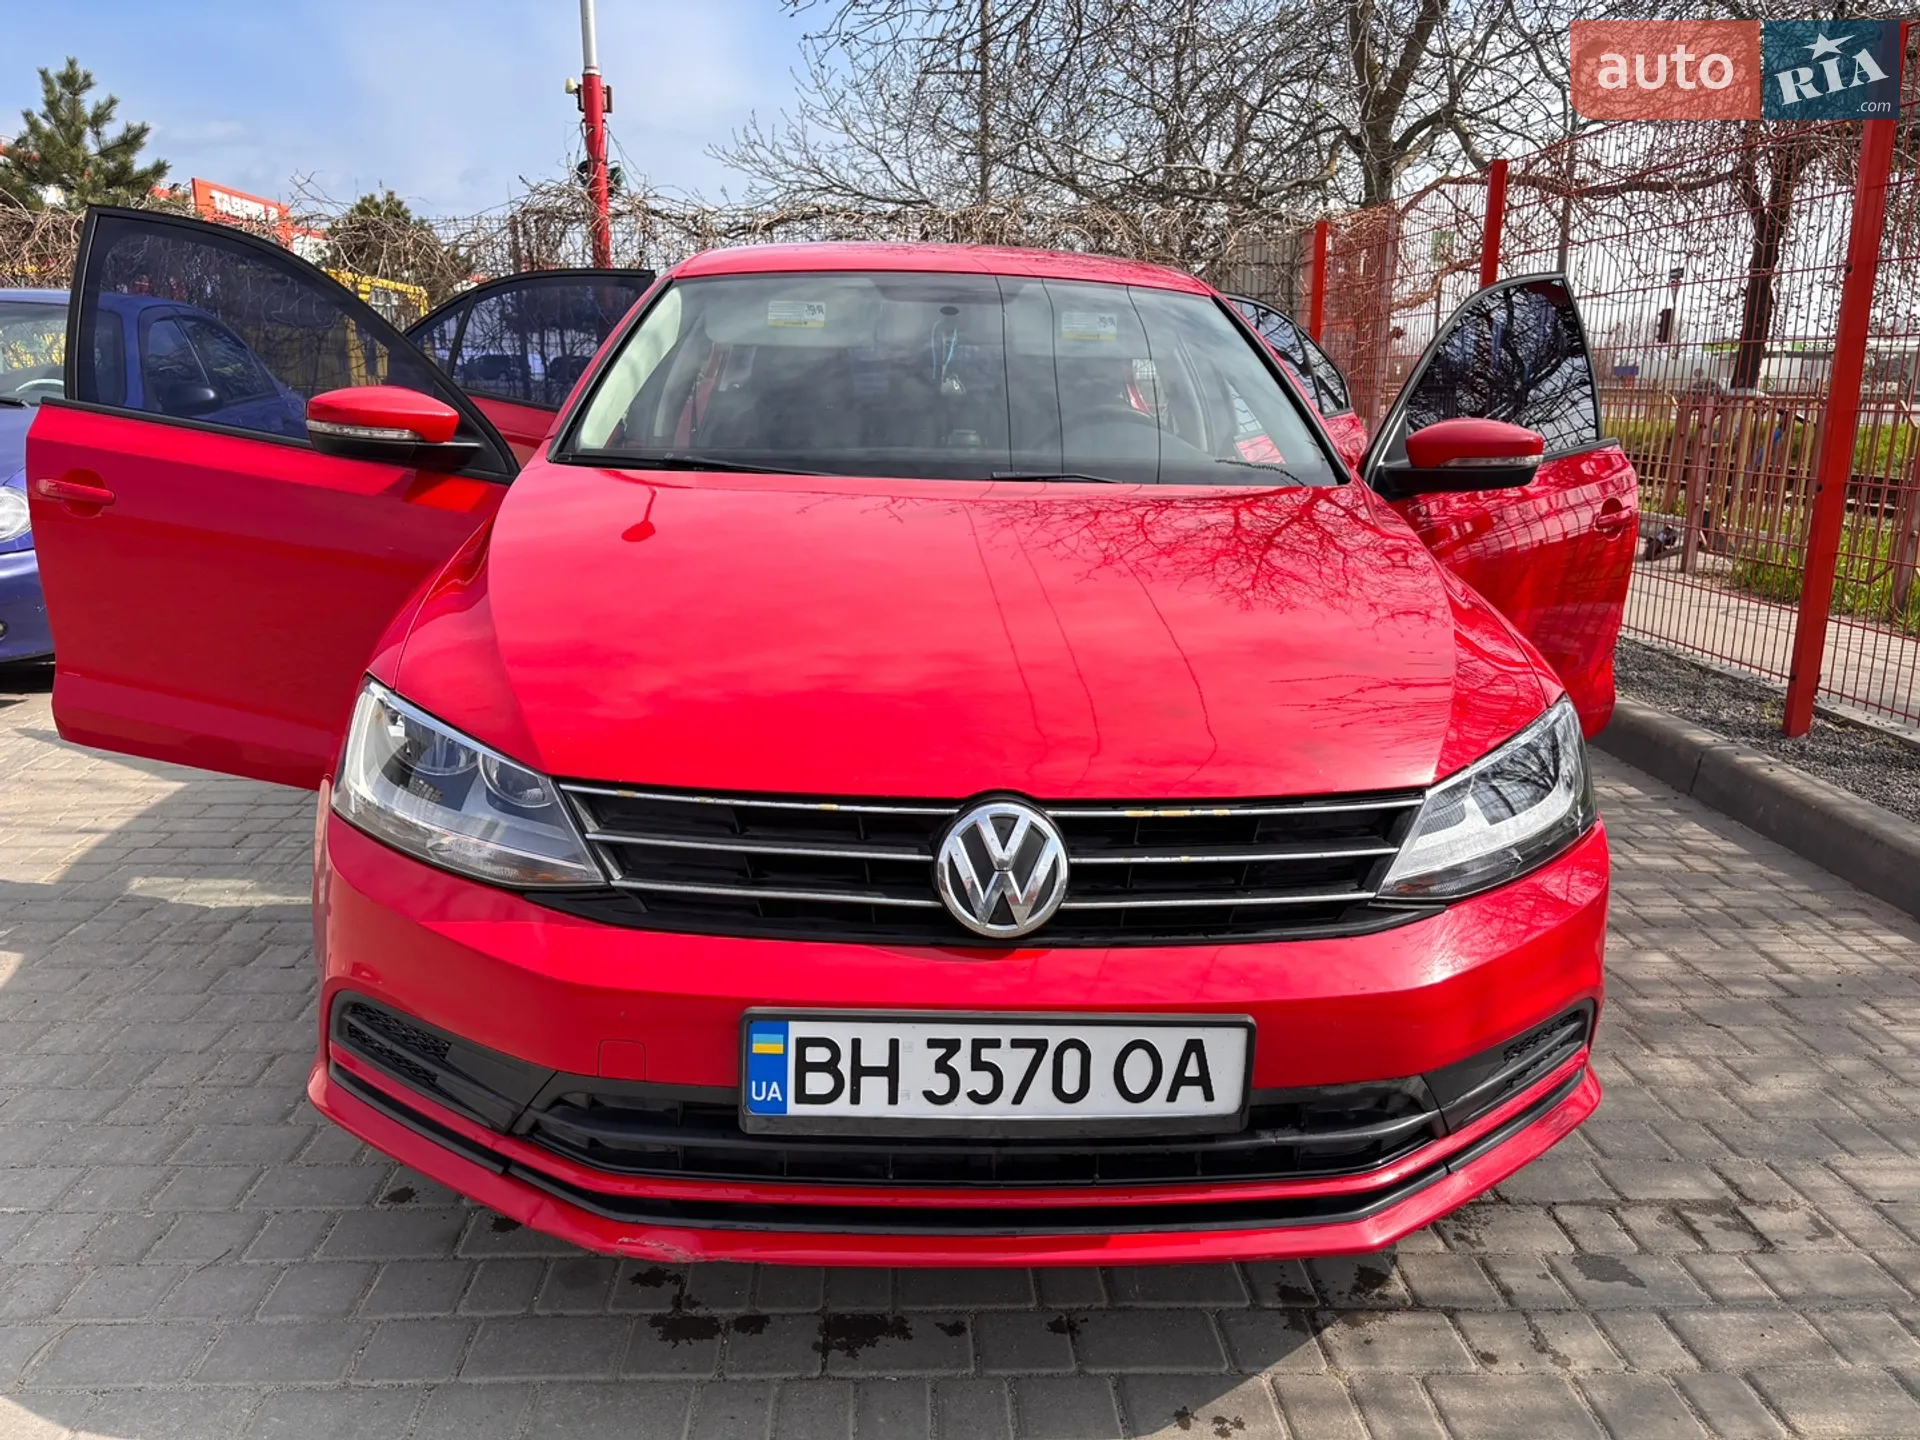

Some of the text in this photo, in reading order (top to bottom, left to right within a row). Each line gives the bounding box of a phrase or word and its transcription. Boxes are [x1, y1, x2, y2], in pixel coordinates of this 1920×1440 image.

[752, 1081, 783, 1102] UA
[794, 1036, 1216, 1106] BH 3570 OA
